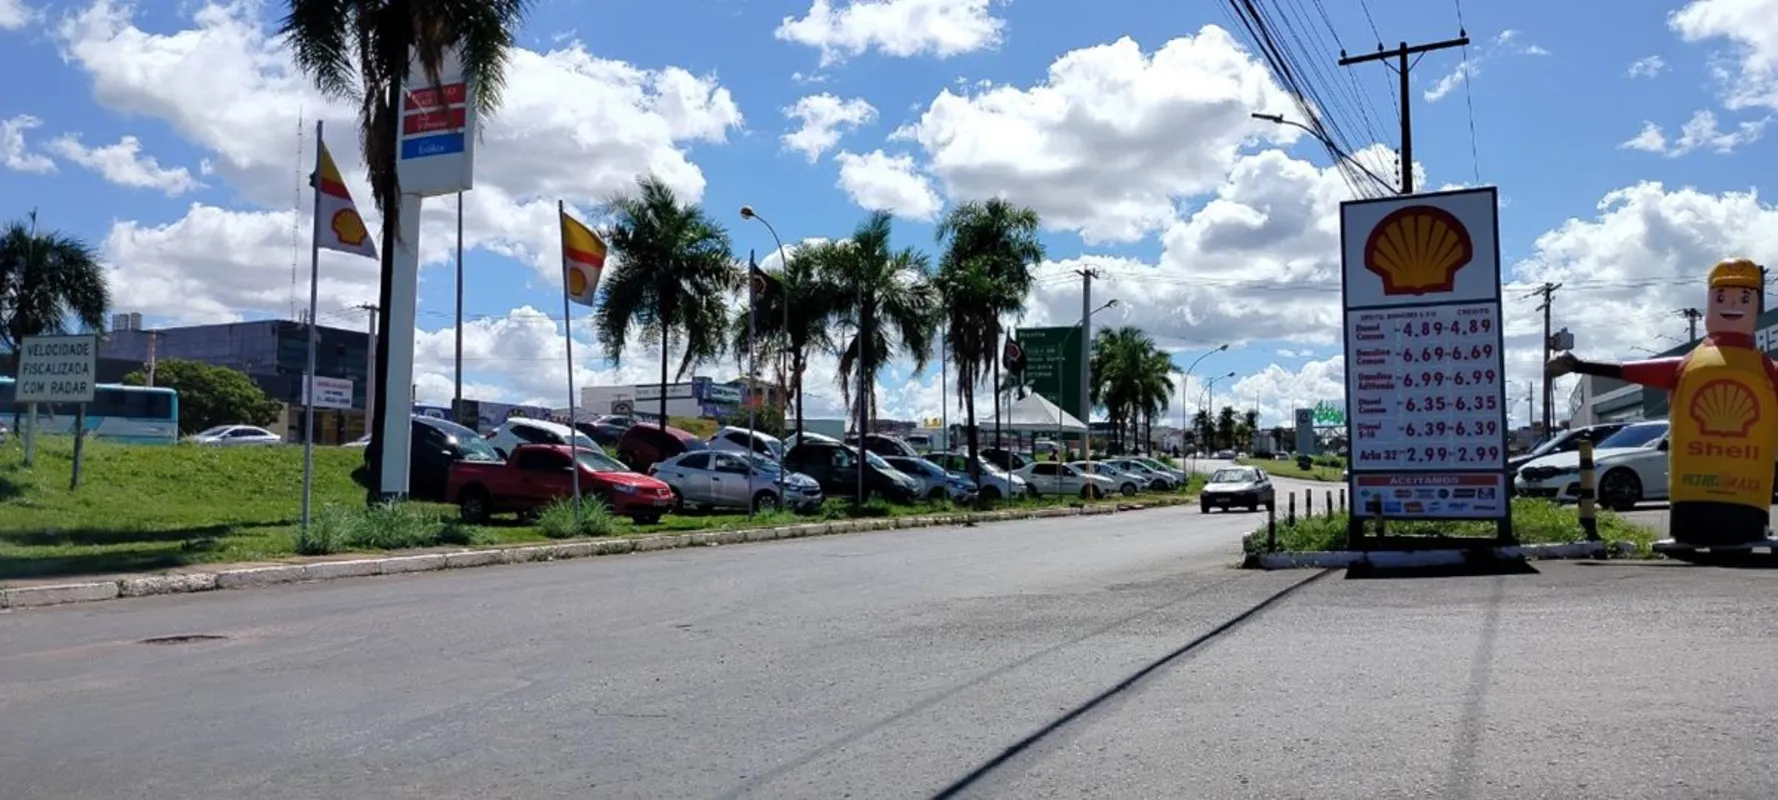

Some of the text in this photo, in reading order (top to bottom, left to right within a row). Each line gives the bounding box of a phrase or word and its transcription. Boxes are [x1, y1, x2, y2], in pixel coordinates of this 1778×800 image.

[1402, 321, 1443, 338] 4.89
[1450, 318, 1492, 336] 4.89
[26, 343, 90, 357] VELOCIDADE
[1402, 347, 1444, 363] 6.69
[1452, 344, 1493, 361] 6.69
[22, 362, 90, 375] FISCALIZADA
[22, 381, 88, 394] COM RADAR
[1403, 371, 1444, 388] 6.99
[1454, 369, 1496, 386] 6.99
[1405, 396, 1446, 413] 6.35
[1455, 395, 1497, 412] 6.35
[1405, 421, 1446, 438] 6.39
[1455, 420, 1497, 437] 6.39
[1407, 447, 1448, 463] 2.99
[1457, 446, 1499, 462] 2.99
[1687, 441, 1760, 461] Shell
[1389, 475, 1459, 485] ACEITAMOS
